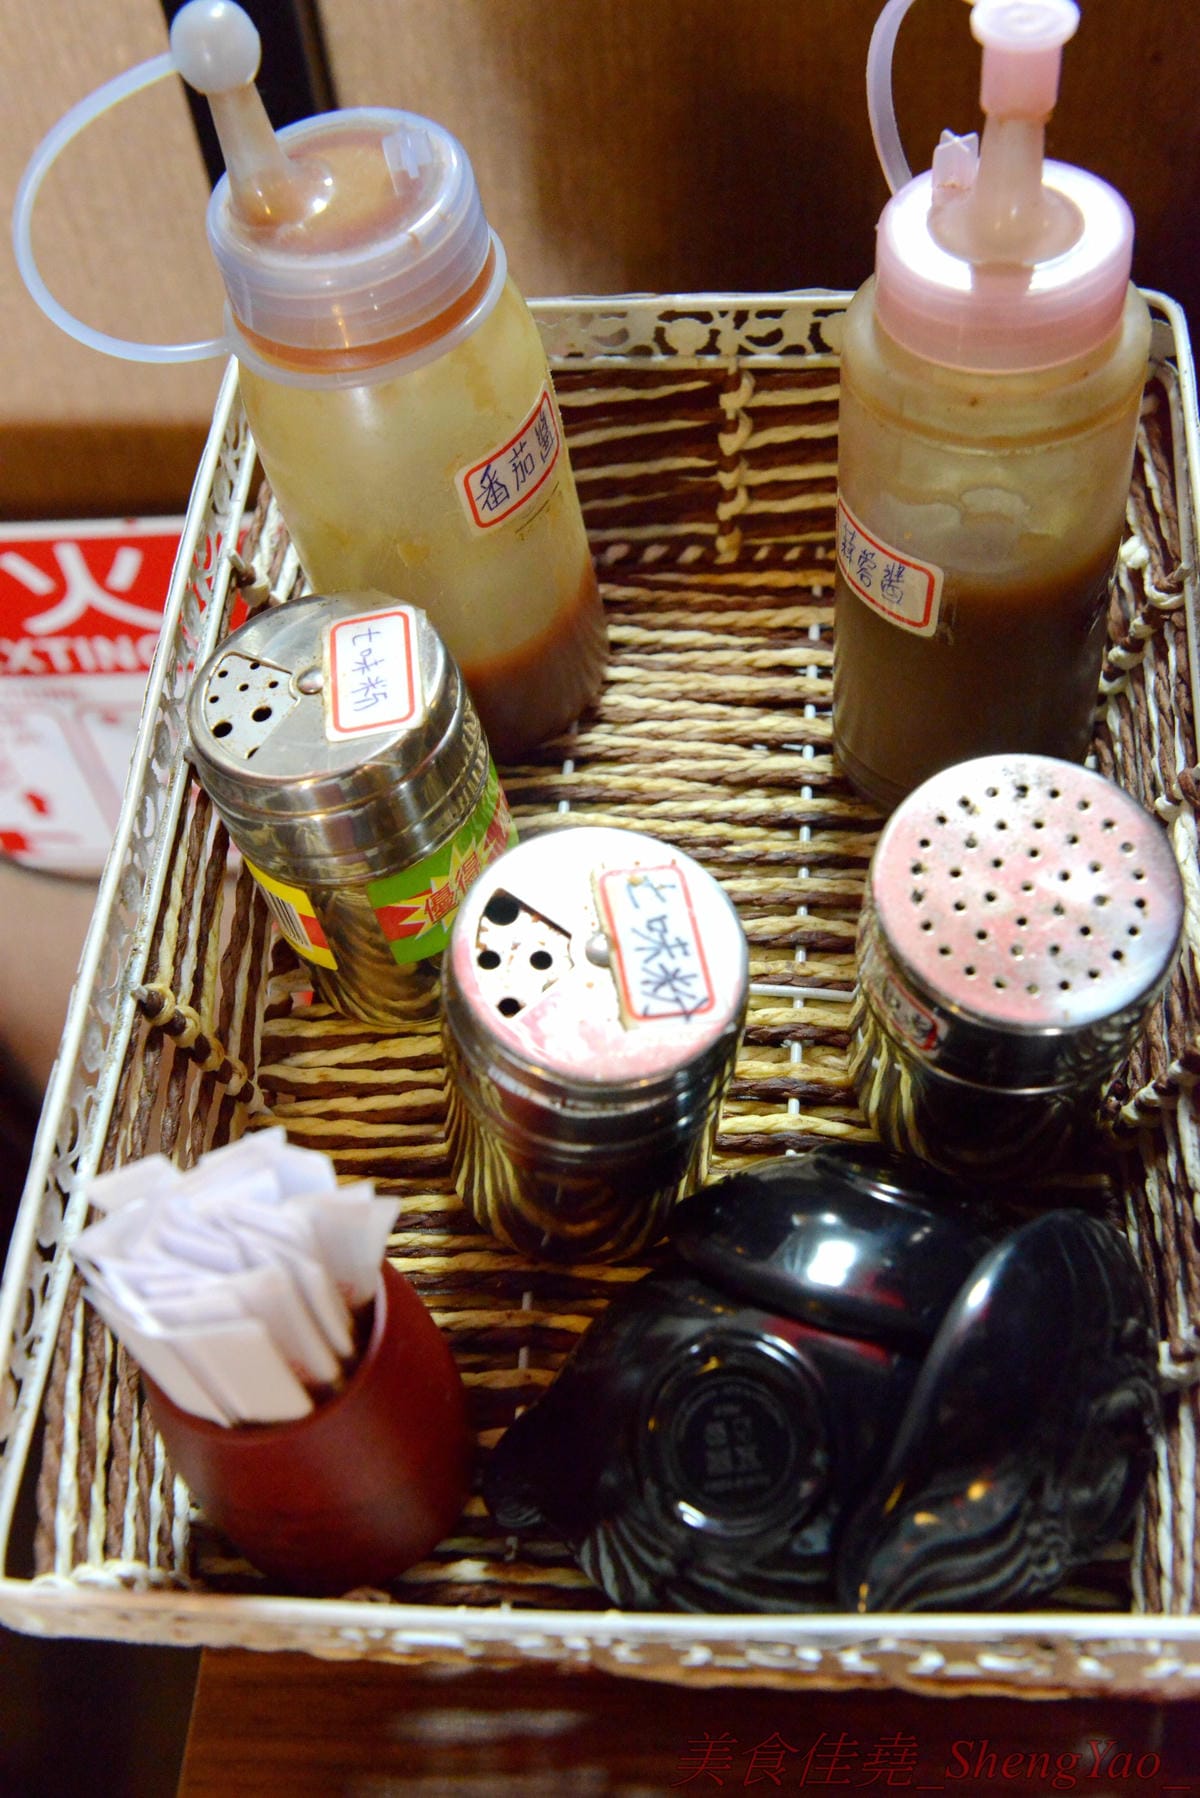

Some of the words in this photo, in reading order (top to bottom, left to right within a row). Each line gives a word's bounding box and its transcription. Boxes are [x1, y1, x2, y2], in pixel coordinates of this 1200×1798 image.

[0, 542, 164, 635] 火
[351, 627, 388, 712] 七味粉
[626, 876, 709, 1022] 七味粉
